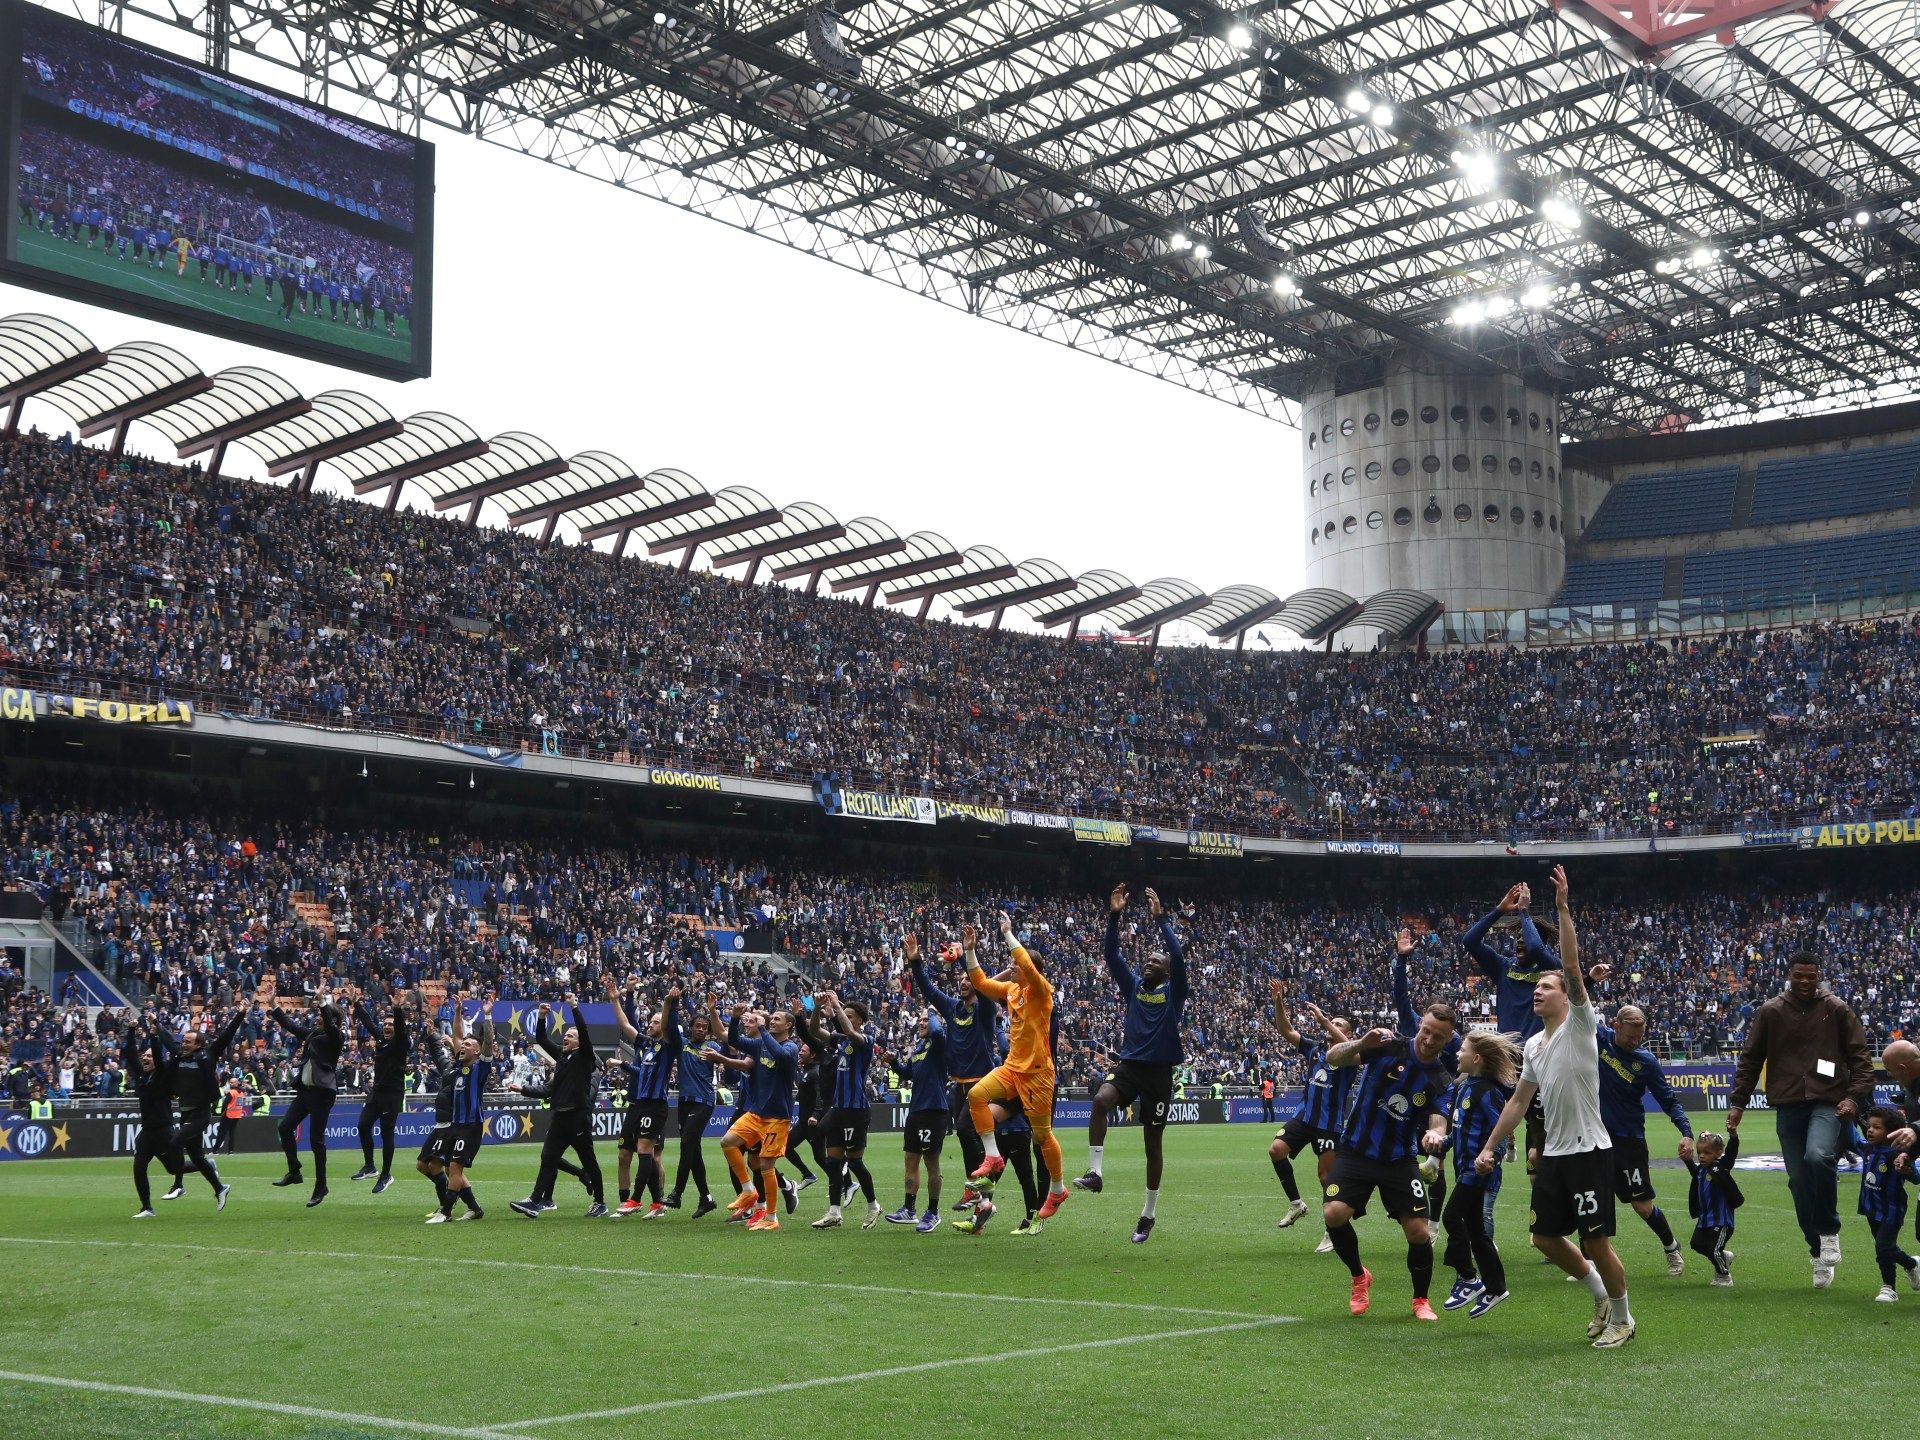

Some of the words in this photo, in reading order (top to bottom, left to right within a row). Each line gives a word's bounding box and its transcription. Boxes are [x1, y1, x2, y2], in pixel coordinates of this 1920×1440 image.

[248, 161, 330, 202] MILANO
[0, 687, 35, 722] CA
[651, 768, 720, 791] GIORGIONE
[845, 791, 918, 818] ROTALIANO
[1199, 832, 1232, 847] MOLE
[1816, 824, 1871, 847] ALTO
[1327, 842, 1361, 853] MILANO
[1372, 844, 1400, 854] OPERA
[1155, 1101, 1166, 1117] 9
[844, 1127, 855, 1141] 17
[1623, 1168, 1643, 1187] 14
[1410, 1178, 1425, 1199] 8
[1573, 1190, 1599, 1217] 23
